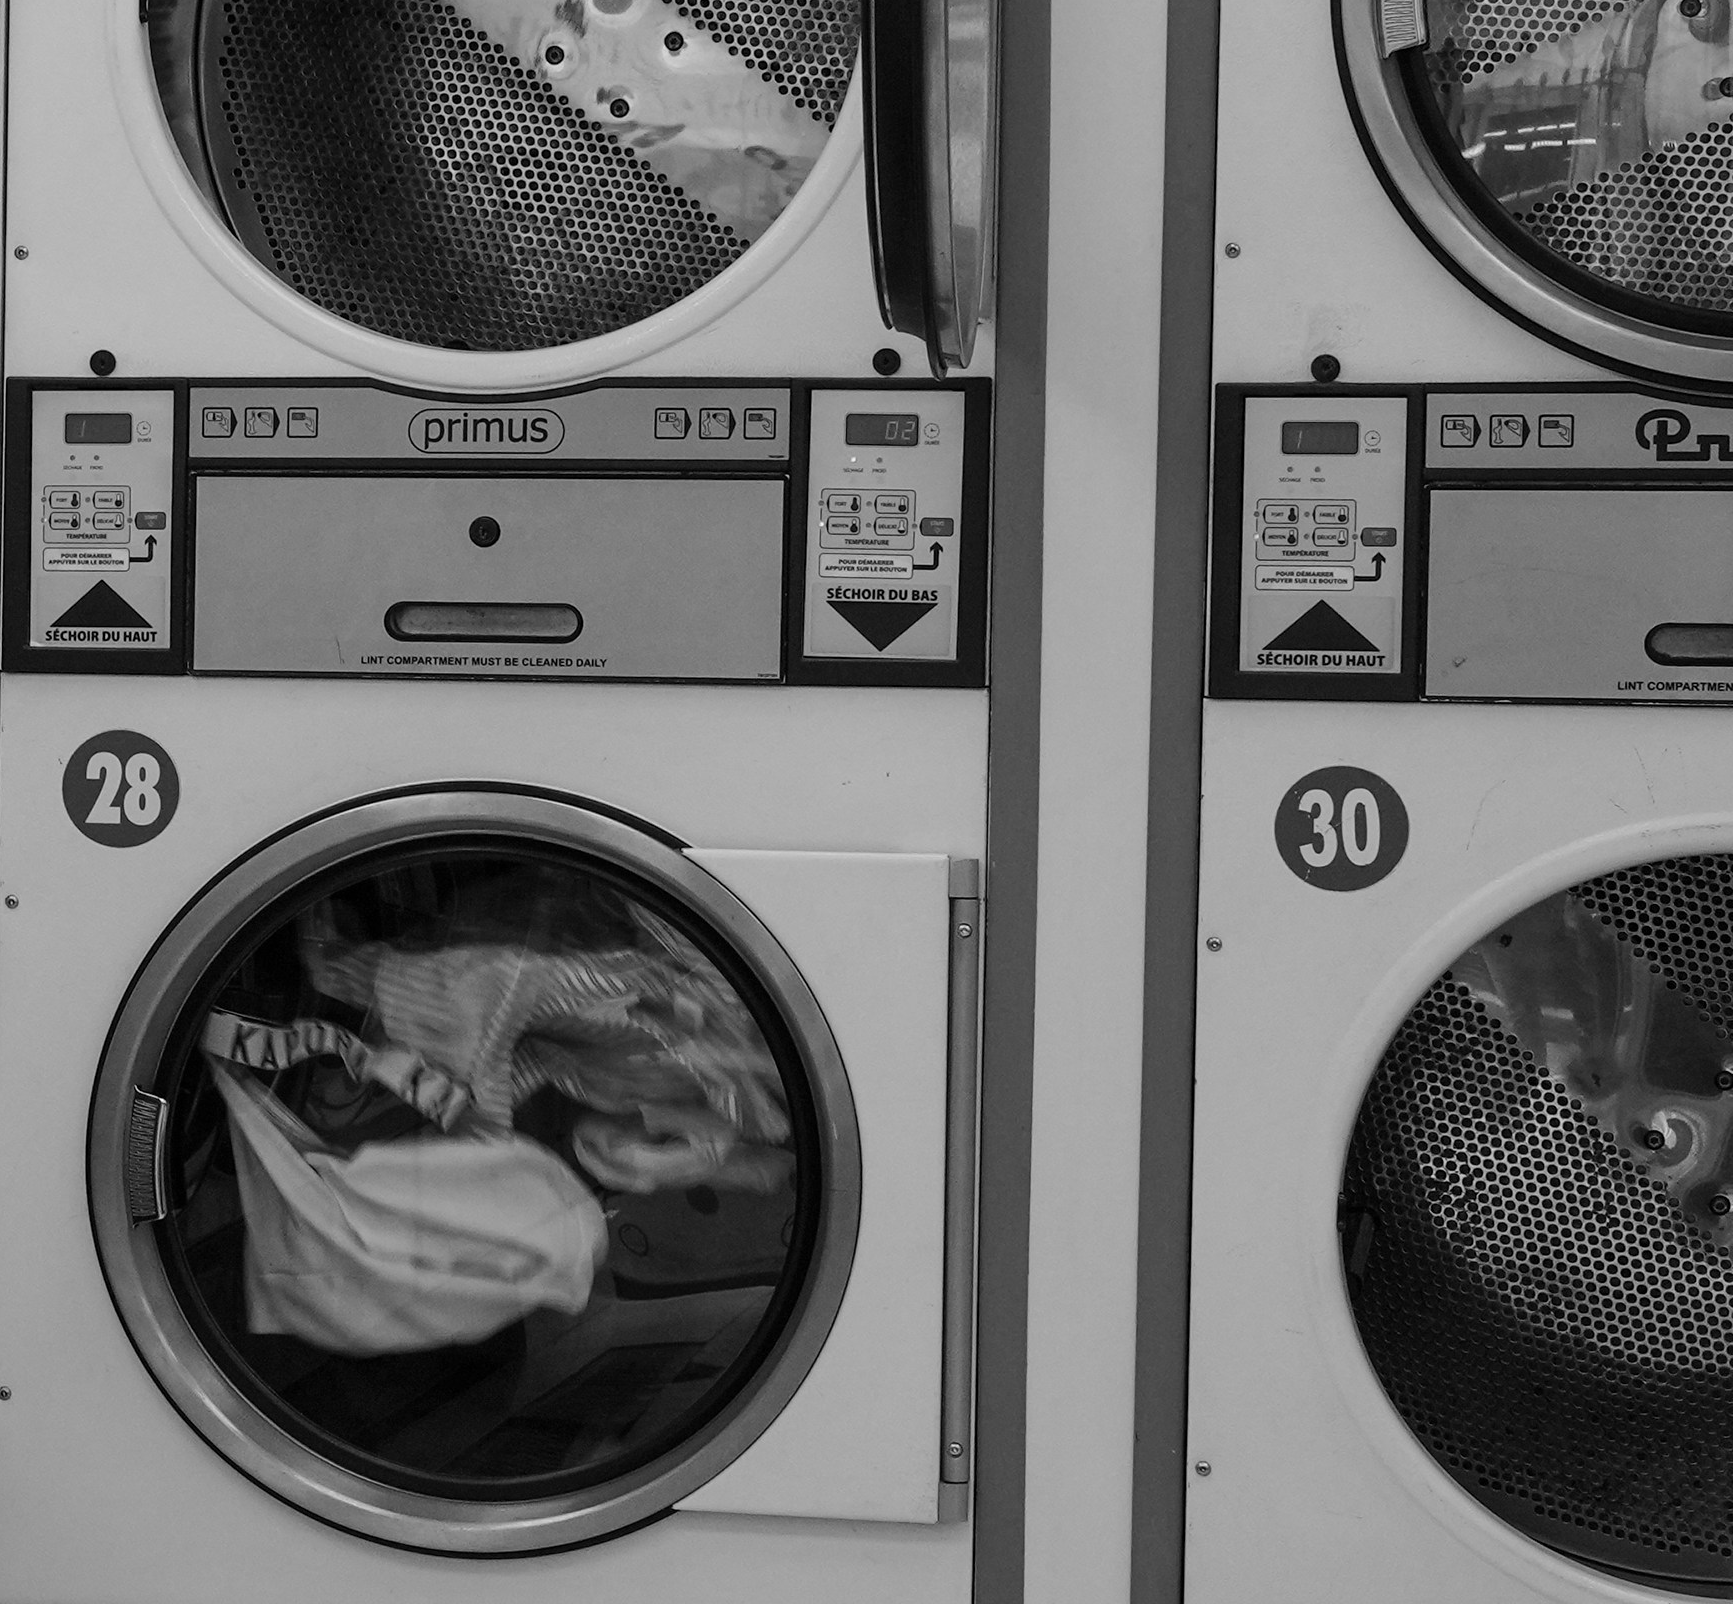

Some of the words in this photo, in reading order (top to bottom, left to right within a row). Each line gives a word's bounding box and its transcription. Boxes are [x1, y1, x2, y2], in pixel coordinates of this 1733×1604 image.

[422, 412, 549, 449] primus
[827, 585, 885, 600] SÉCHOIR
[888, 589, 908, 601] DU
[911, 589, 938, 601] BAS
[45, 628, 99, 642] SÉCHOIR
[102, 630, 120, 642] DU
[123, 631, 158, 642] HAUT
[360, 655, 383, 664] LINT
[386, 655, 469, 666] COMPARTMENT
[471, 657, 502, 666] MUST
[504, 657, 518, 667] BE
[521, 657, 573, 667] CLEANED
[576, 658, 607, 668] DAILY
[1257, 651, 1317, 666] SÉCHOIR
[1321, 654, 1342, 666] DU
[1345, 654, 1386, 667] HAUT
[1617, 681, 1644, 691] LINT
[1646, 681, 1733, 692] COMPARTMEN
[85, 752, 162, 826] 28
[1298, 788, 1381, 868] 30
